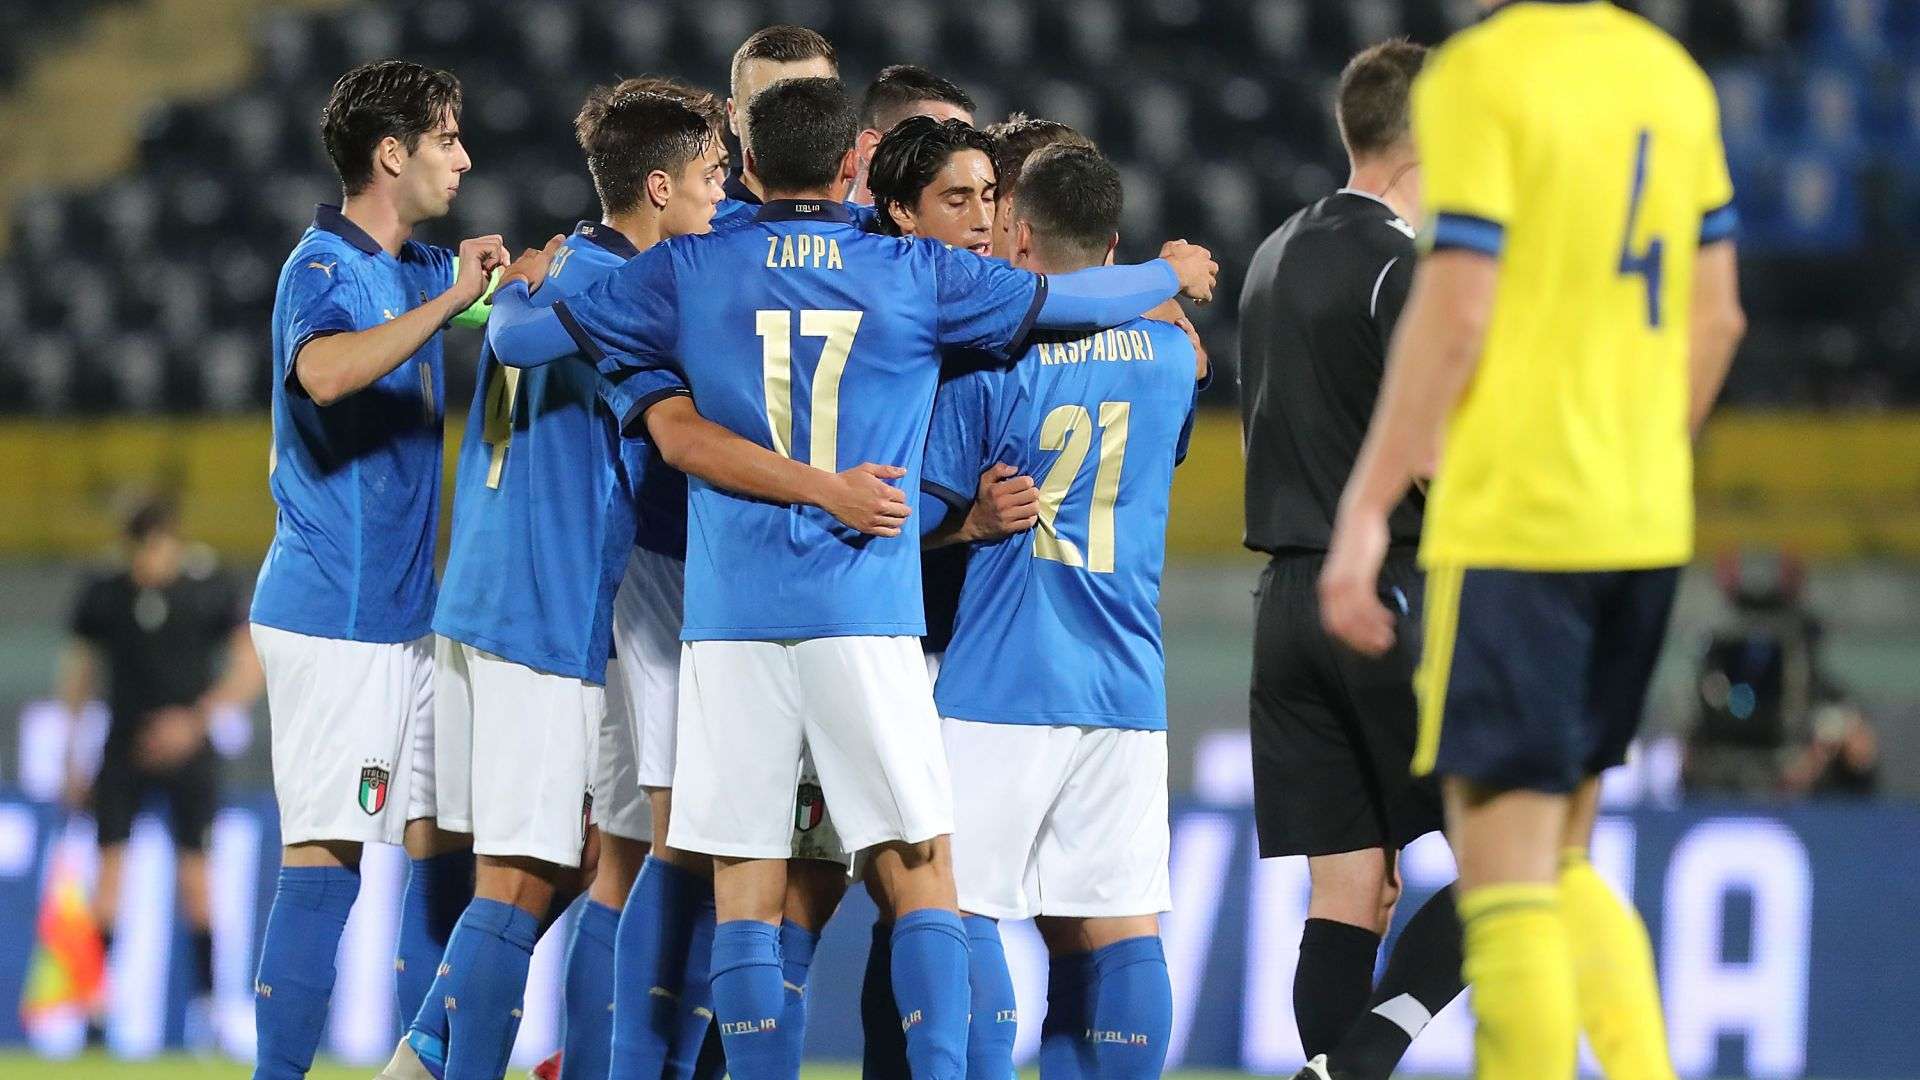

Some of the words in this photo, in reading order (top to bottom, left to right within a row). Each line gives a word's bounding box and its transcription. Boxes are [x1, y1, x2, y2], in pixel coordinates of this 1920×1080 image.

[795, 204, 821, 213] ITALIA
[1617, 124, 1665, 330] 4
[766, 234, 843, 270] ZAPPA
[1037, 328, 1154, 365] RASPADORI
[755, 309, 864, 474] 17
[1033, 401, 1130, 573] 21
[721, 1018, 777, 1035] ITALIA
